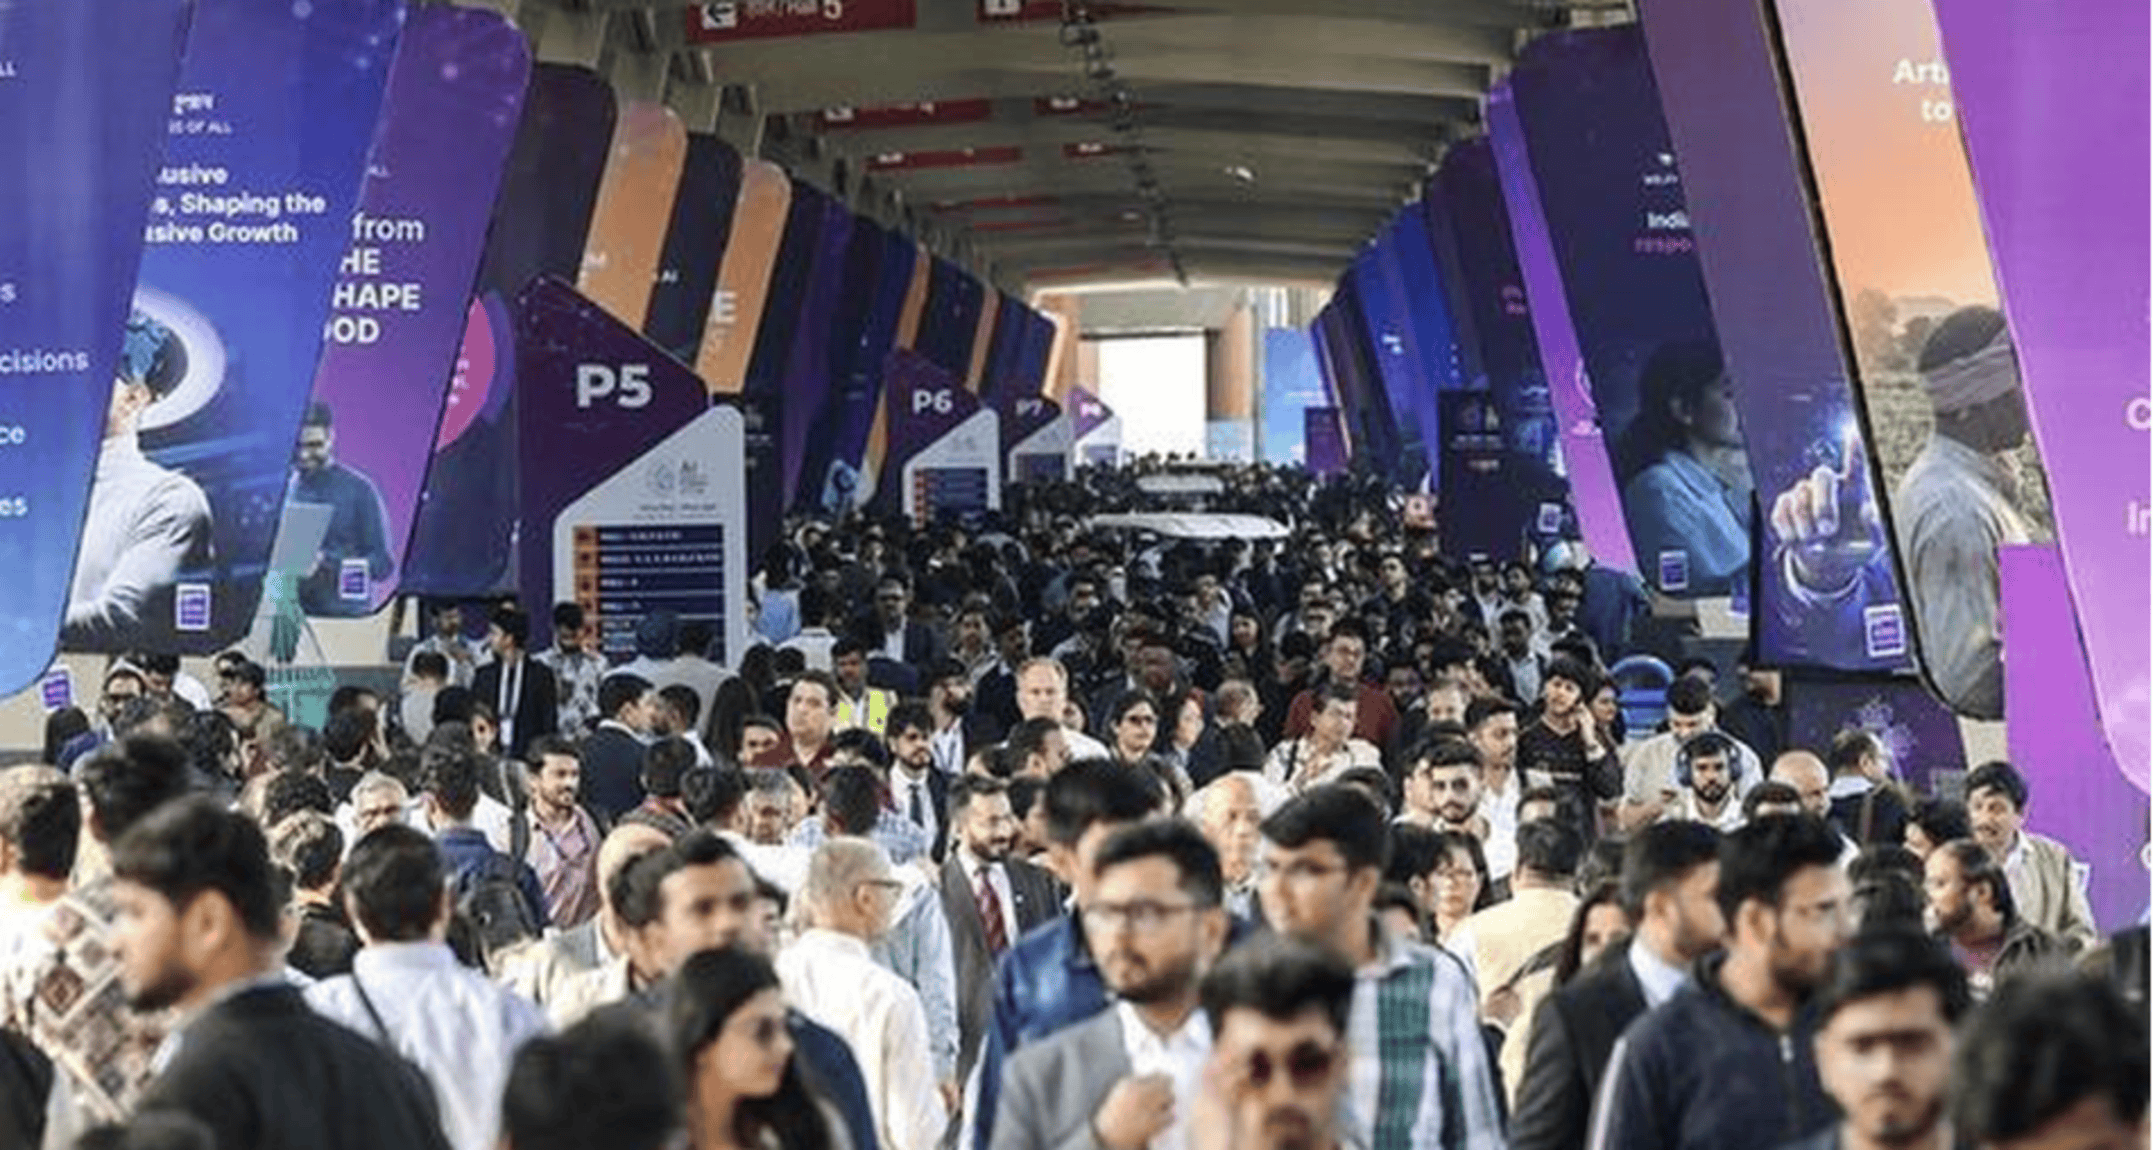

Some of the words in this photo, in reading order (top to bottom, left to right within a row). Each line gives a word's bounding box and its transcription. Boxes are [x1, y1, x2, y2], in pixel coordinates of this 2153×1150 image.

[1921, 99, 1953, 121] to
[156, 164, 229, 185] usive
[180, 192, 281, 219] Shaping
[285, 191, 327, 214] the
[208, 221, 299, 243] Growth
[352, 211, 425, 242] from
[332, 282, 422, 311] HAPE
[576, 363, 653, 408] P5
[912, 388, 953, 416] P6
[1015, 399, 1044, 417] P7
